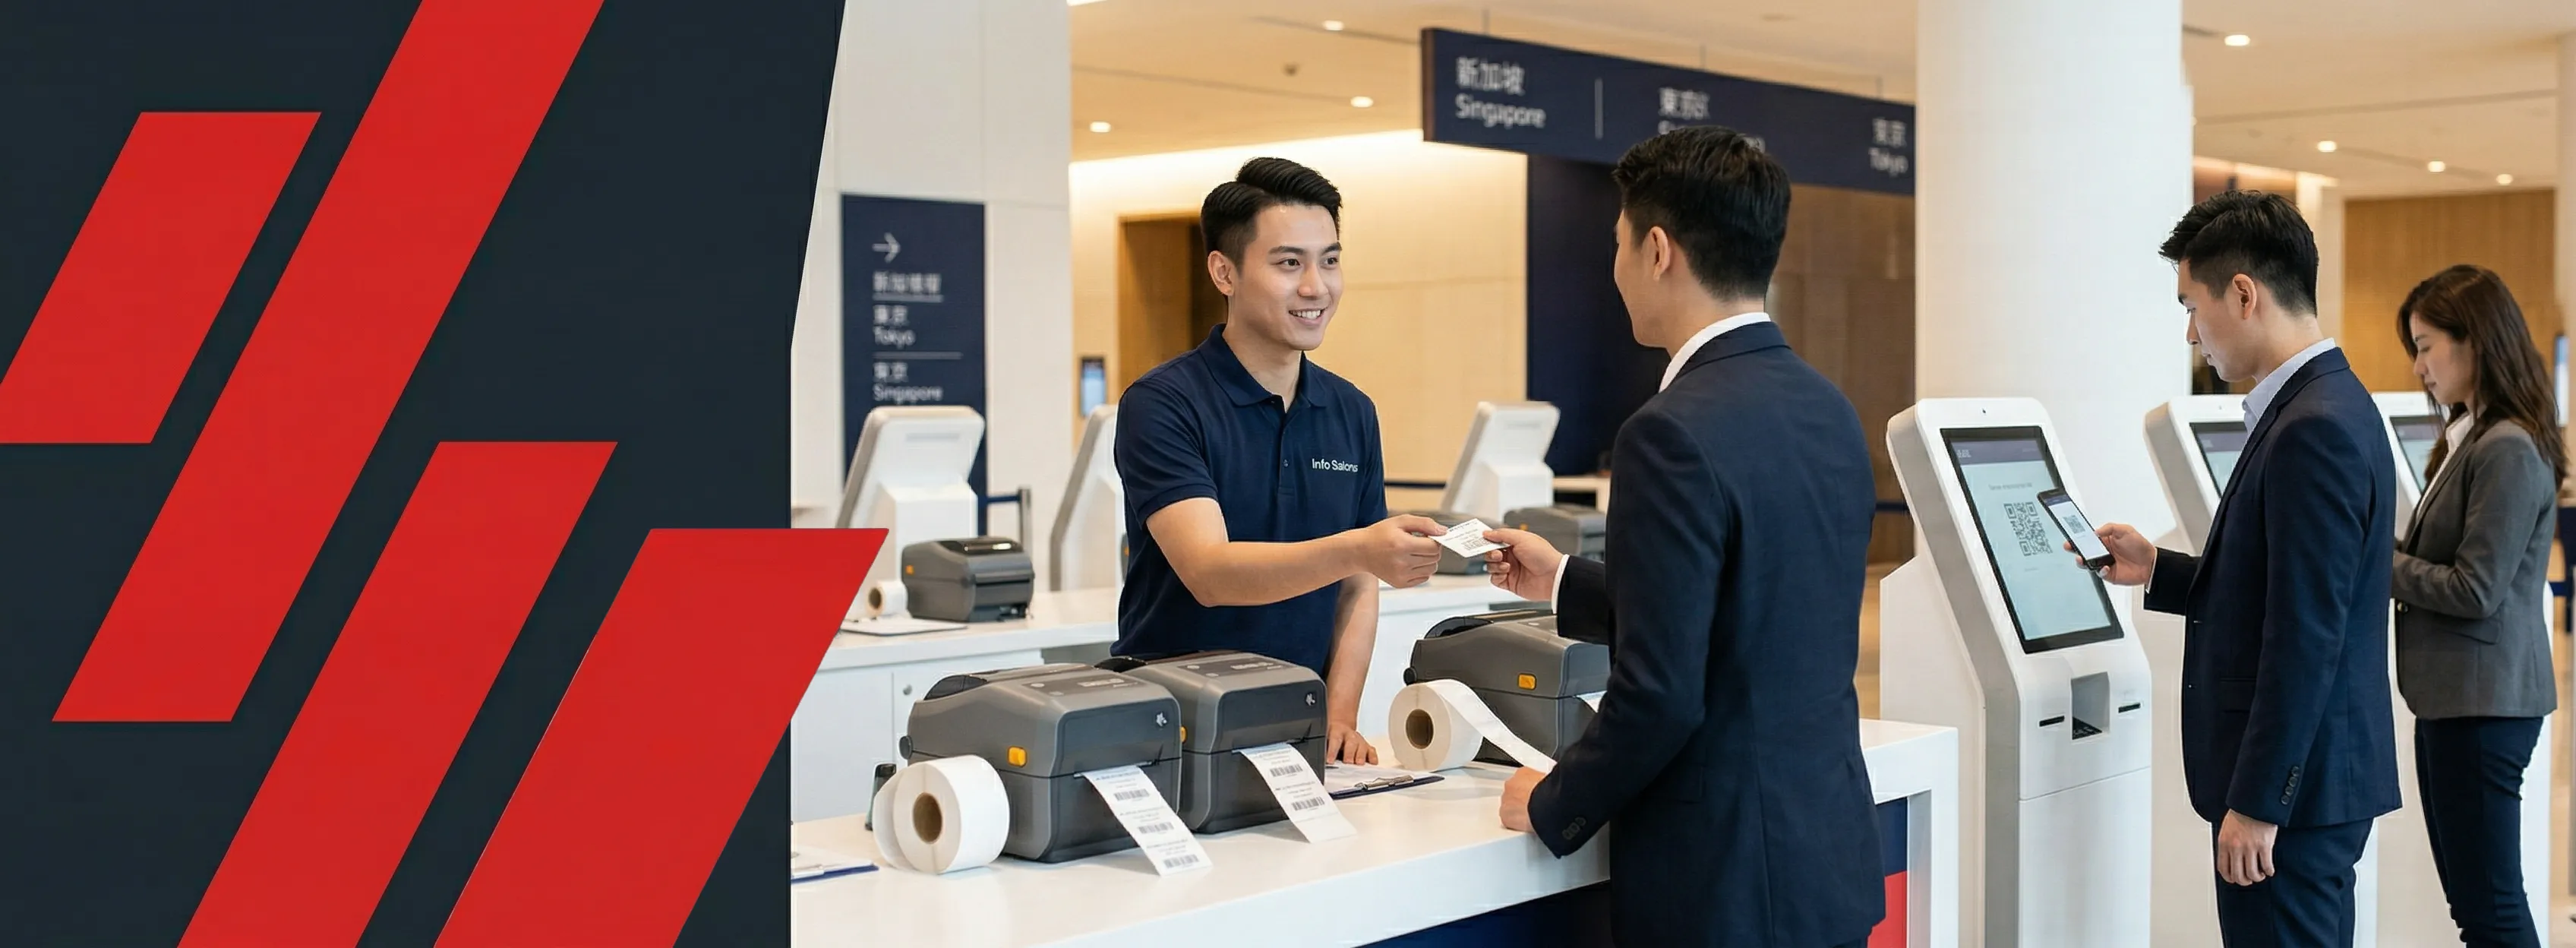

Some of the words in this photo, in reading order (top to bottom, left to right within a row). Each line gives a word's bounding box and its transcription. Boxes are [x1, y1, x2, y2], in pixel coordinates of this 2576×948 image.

[1455, 93, 1546, 128] Singapore
[873, 326, 916, 349] Tokyo
[1312, 458, 1331, 470] Info
[1331, 460, 1359, 472] Salons
